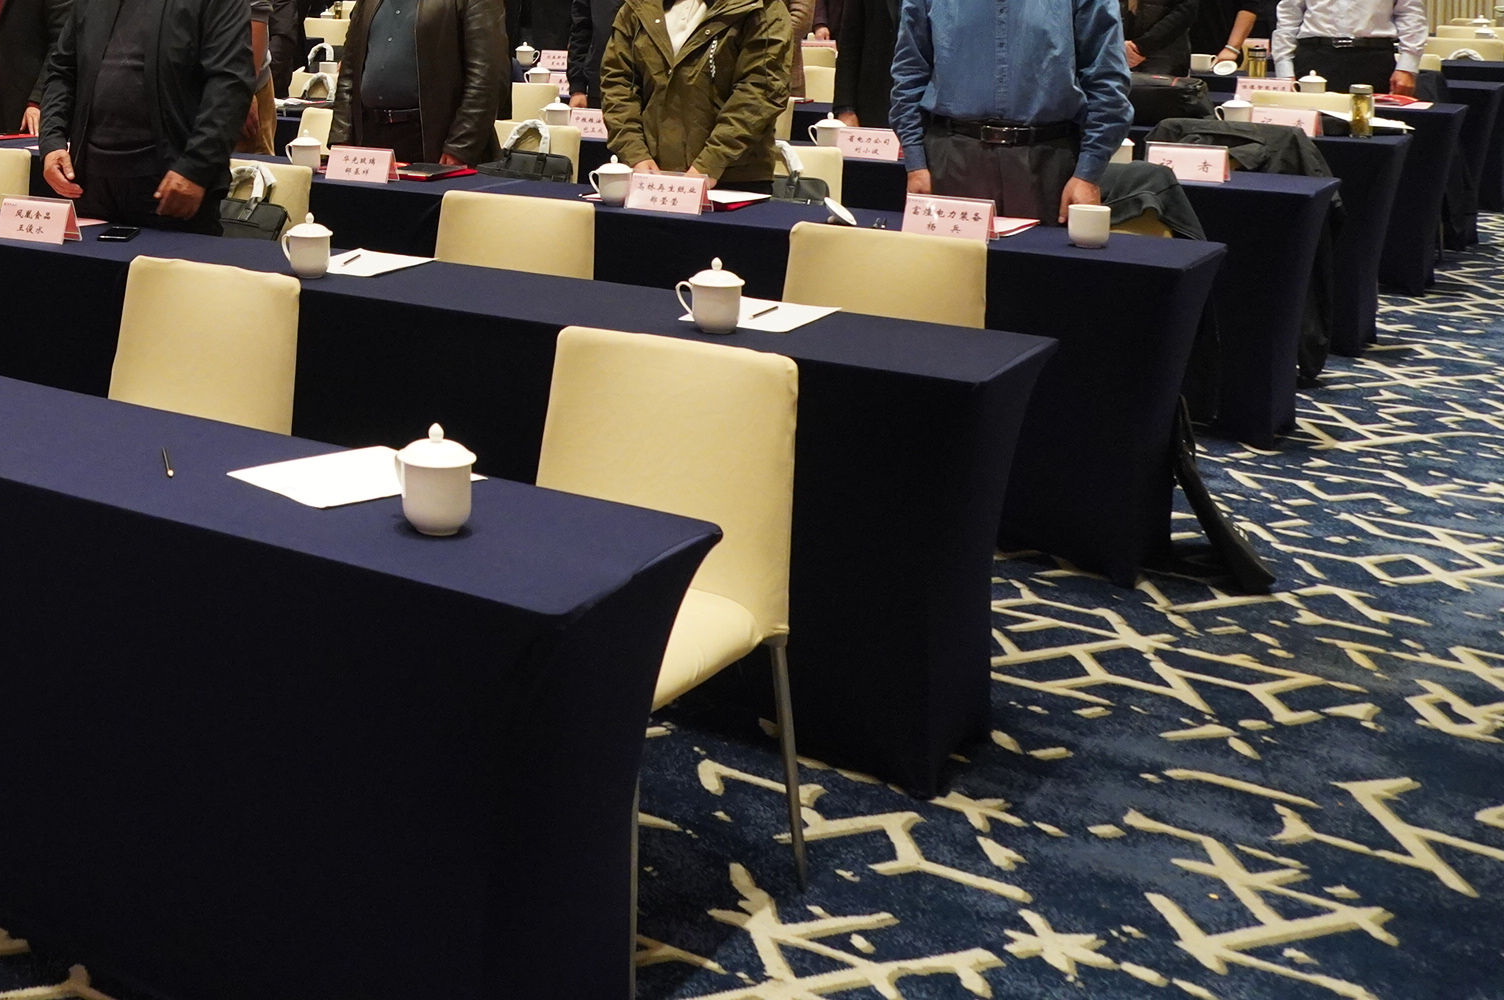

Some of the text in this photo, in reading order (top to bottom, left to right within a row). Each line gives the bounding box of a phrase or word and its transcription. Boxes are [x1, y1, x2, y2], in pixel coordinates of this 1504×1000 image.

[848, 135, 890, 145] 省电力公司
[15, 209, 51, 220] 凤凰食品
[912, 205, 982, 222] 富煌电力装备
